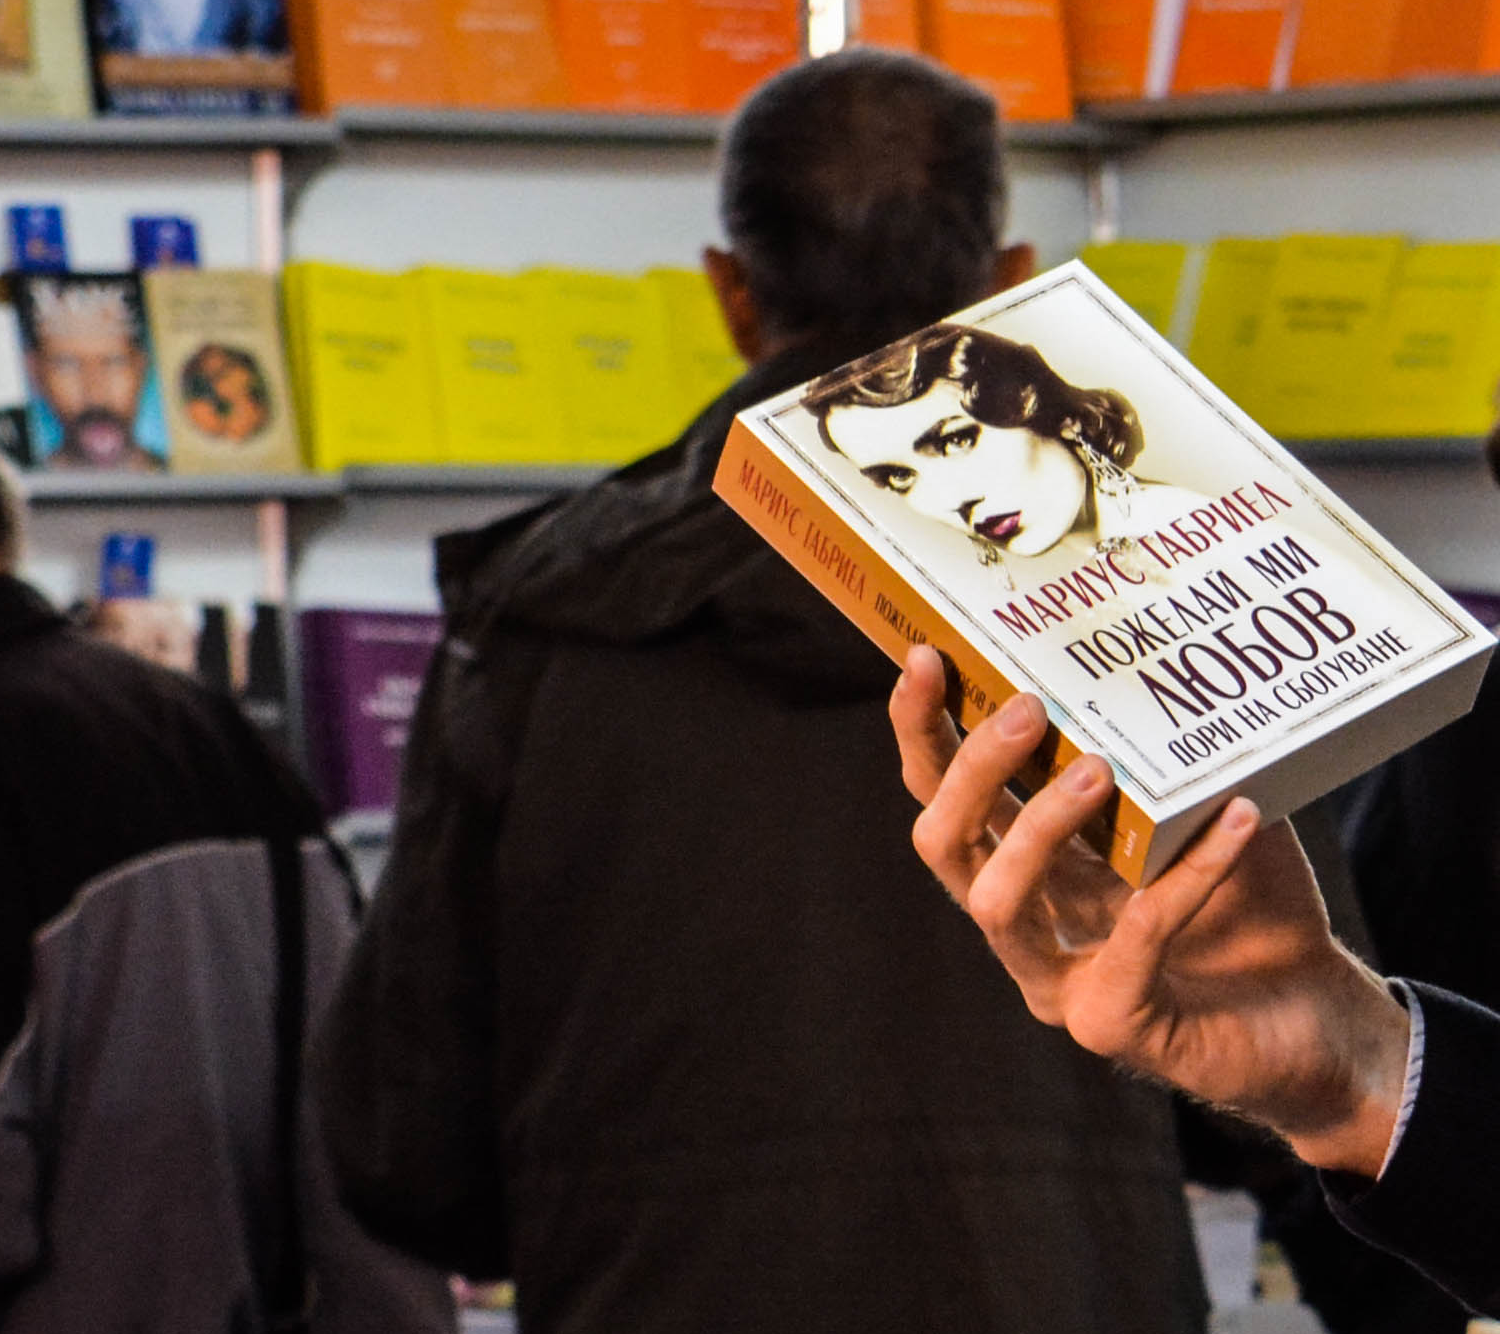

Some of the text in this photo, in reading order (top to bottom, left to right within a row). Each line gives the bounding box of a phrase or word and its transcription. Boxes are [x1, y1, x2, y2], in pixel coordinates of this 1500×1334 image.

[739, 458, 803, 540] МАРИУС
[802, 520, 867, 603] ГАБРИЕЛ
[991, 480, 1293, 641] МАРИУС ГАБРИЕЛ
[1064, 533, 1322, 683] ПОЖЕЛАЙ МИ
[1138, 585, 1358, 729] ЛЮБОВ
[1167, 719, 1238, 768] ДОРИ
[1239, 697, 1280, 736] НА
[1270, 624, 1413, 716] СБОГУВАНЕ
